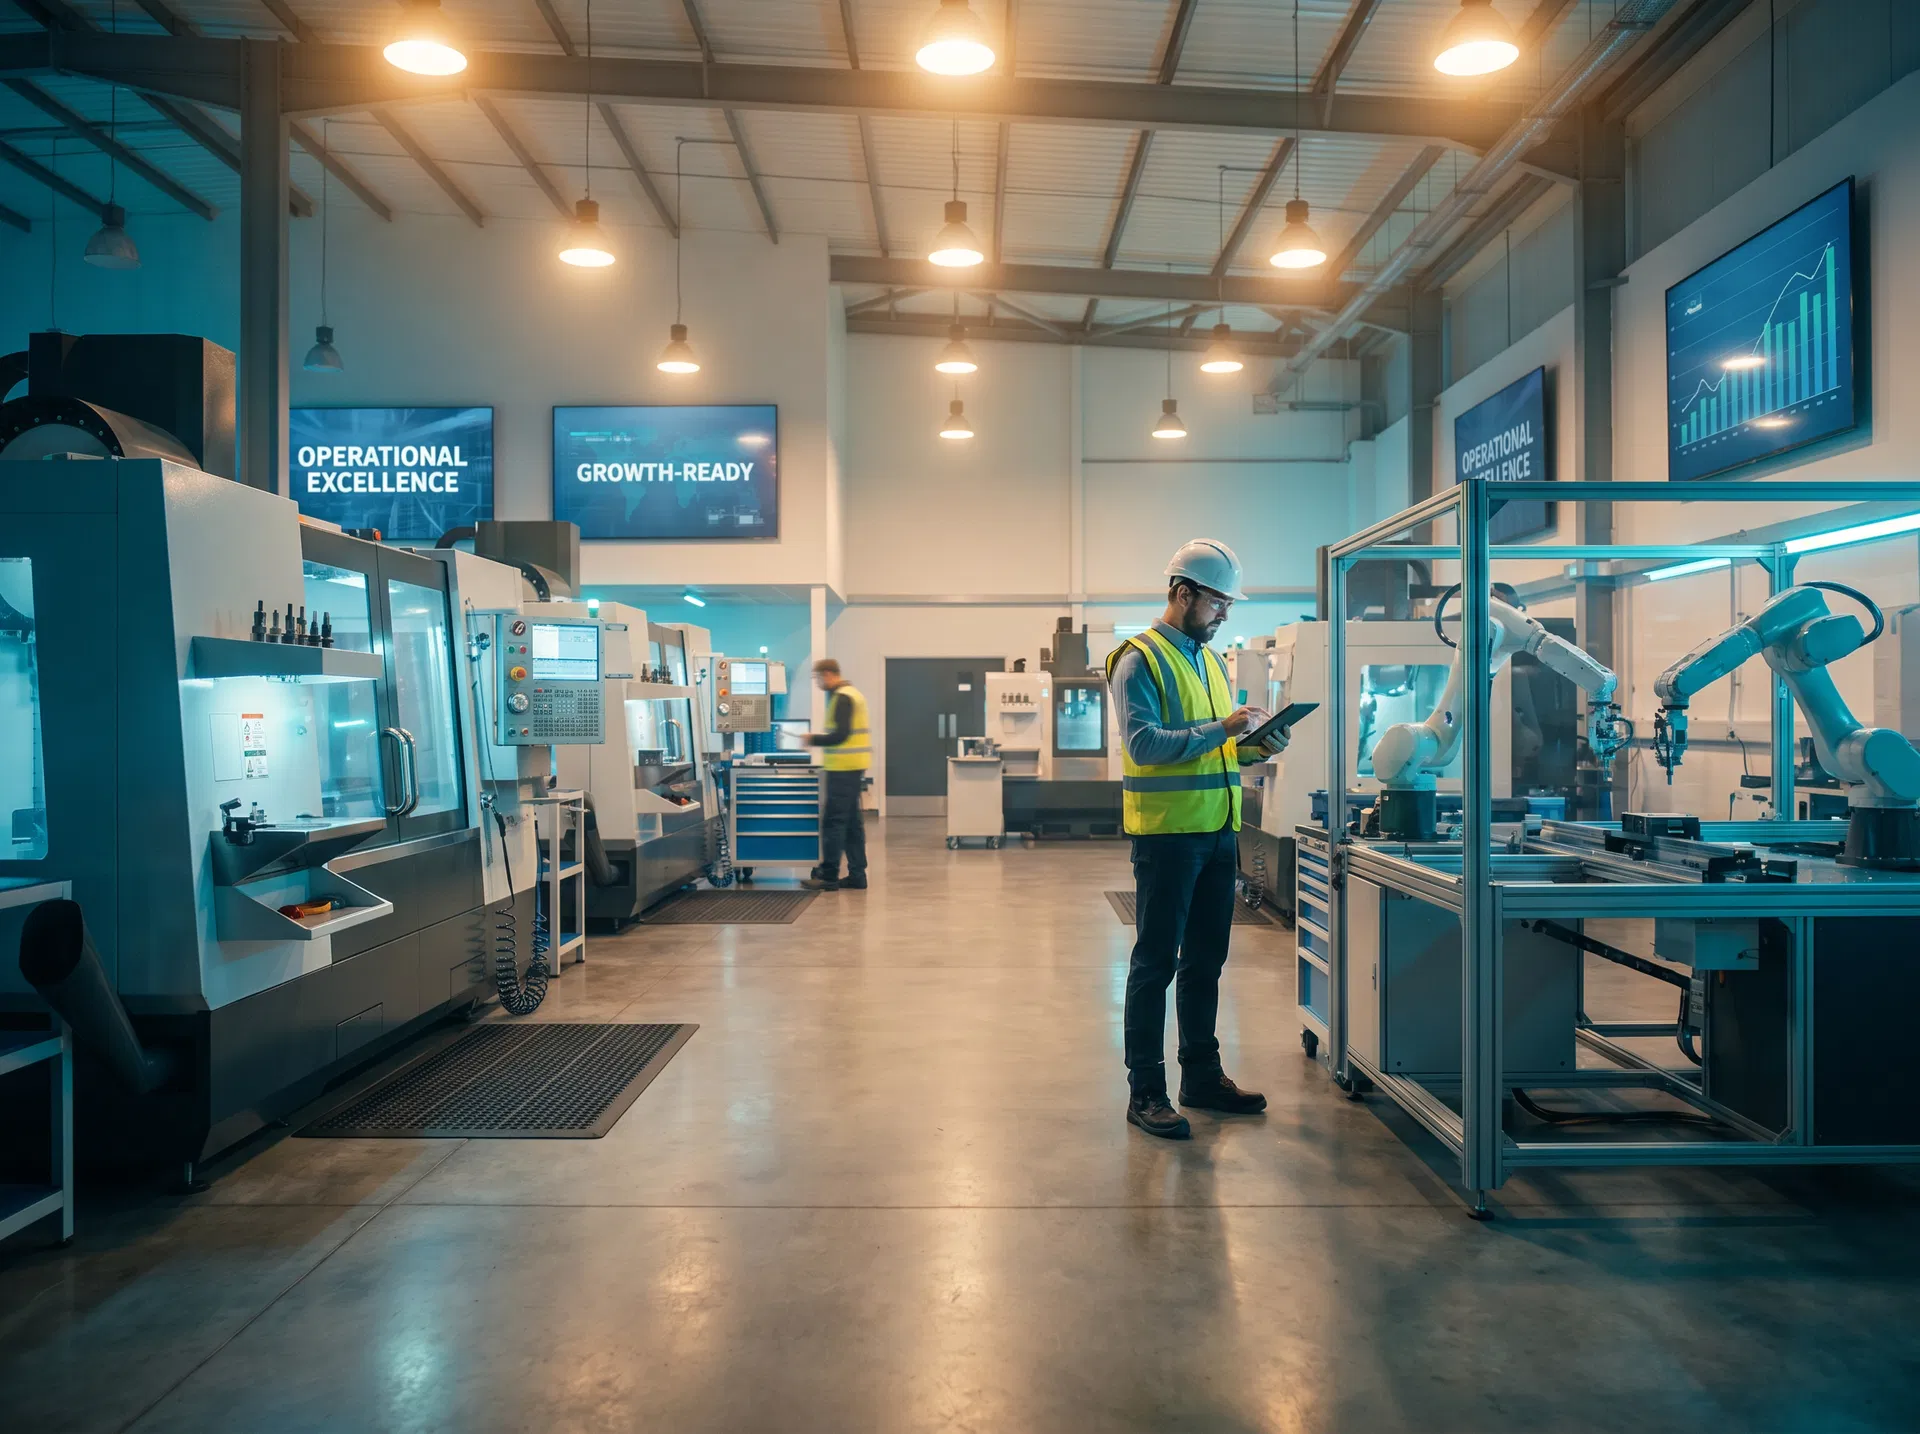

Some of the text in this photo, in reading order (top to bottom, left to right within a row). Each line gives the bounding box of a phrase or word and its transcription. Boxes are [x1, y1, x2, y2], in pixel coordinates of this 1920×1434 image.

[297, 445, 468, 467] OPERATIONAL
[1462, 420, 1533, 474] OPERATIONAL
[307, 471, 459, 493] EXCELLENCE
[576, 462, 754, 483] GROWTH-READY
